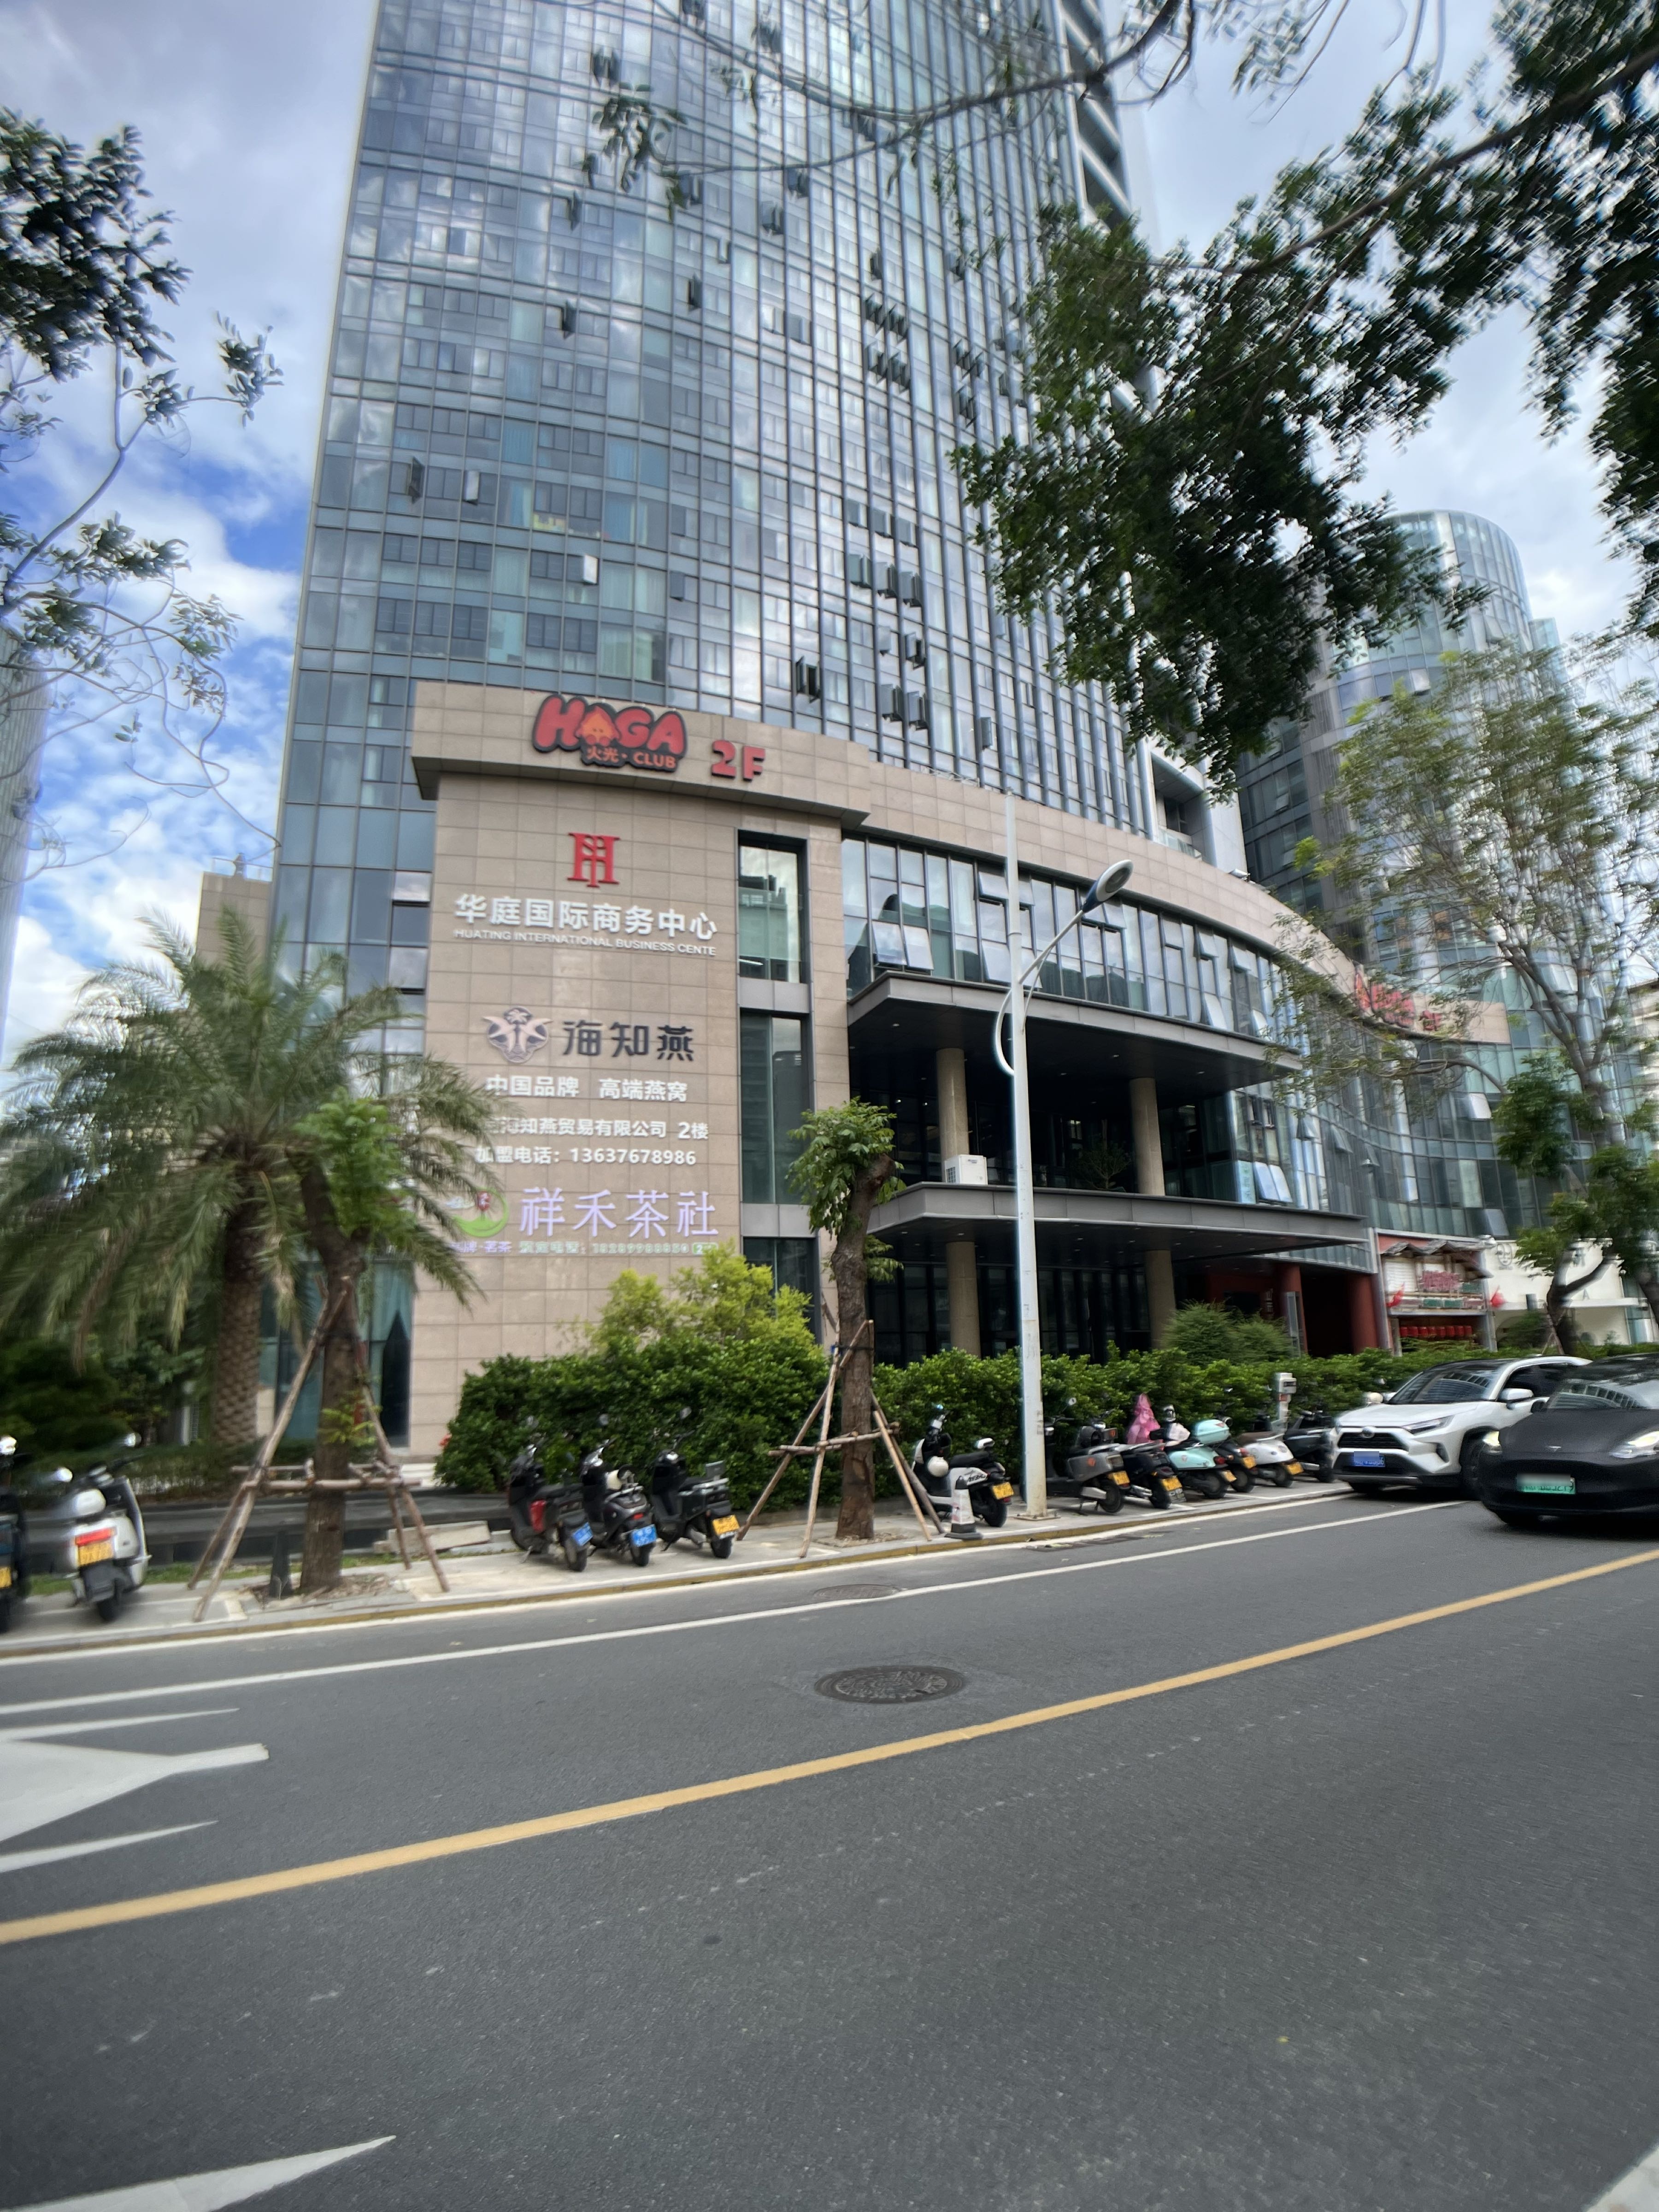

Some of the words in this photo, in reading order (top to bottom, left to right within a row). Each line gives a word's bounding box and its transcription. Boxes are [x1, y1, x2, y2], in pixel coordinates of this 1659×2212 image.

[711, 740, 766, 782] 2F
[454, 893, 718, 941] 华庭国际商务中心
[453, 929, 511, 941] HUATING
[513, 931, 613, 947] INTERNATIONAL
[615, 938, 676, 952] BUSINESS
[677, 943, 717, 956] CENTE
[562, 1020, 694, 1062] 海知燕
[485, 1074, 580, 1098] 中国品牌
[598, 1077, 688, 1102] 高端燕窝
[677, 1122, 709, 1140] 2楼
[519, 1187, 719, 1239] 祥禾茶社
